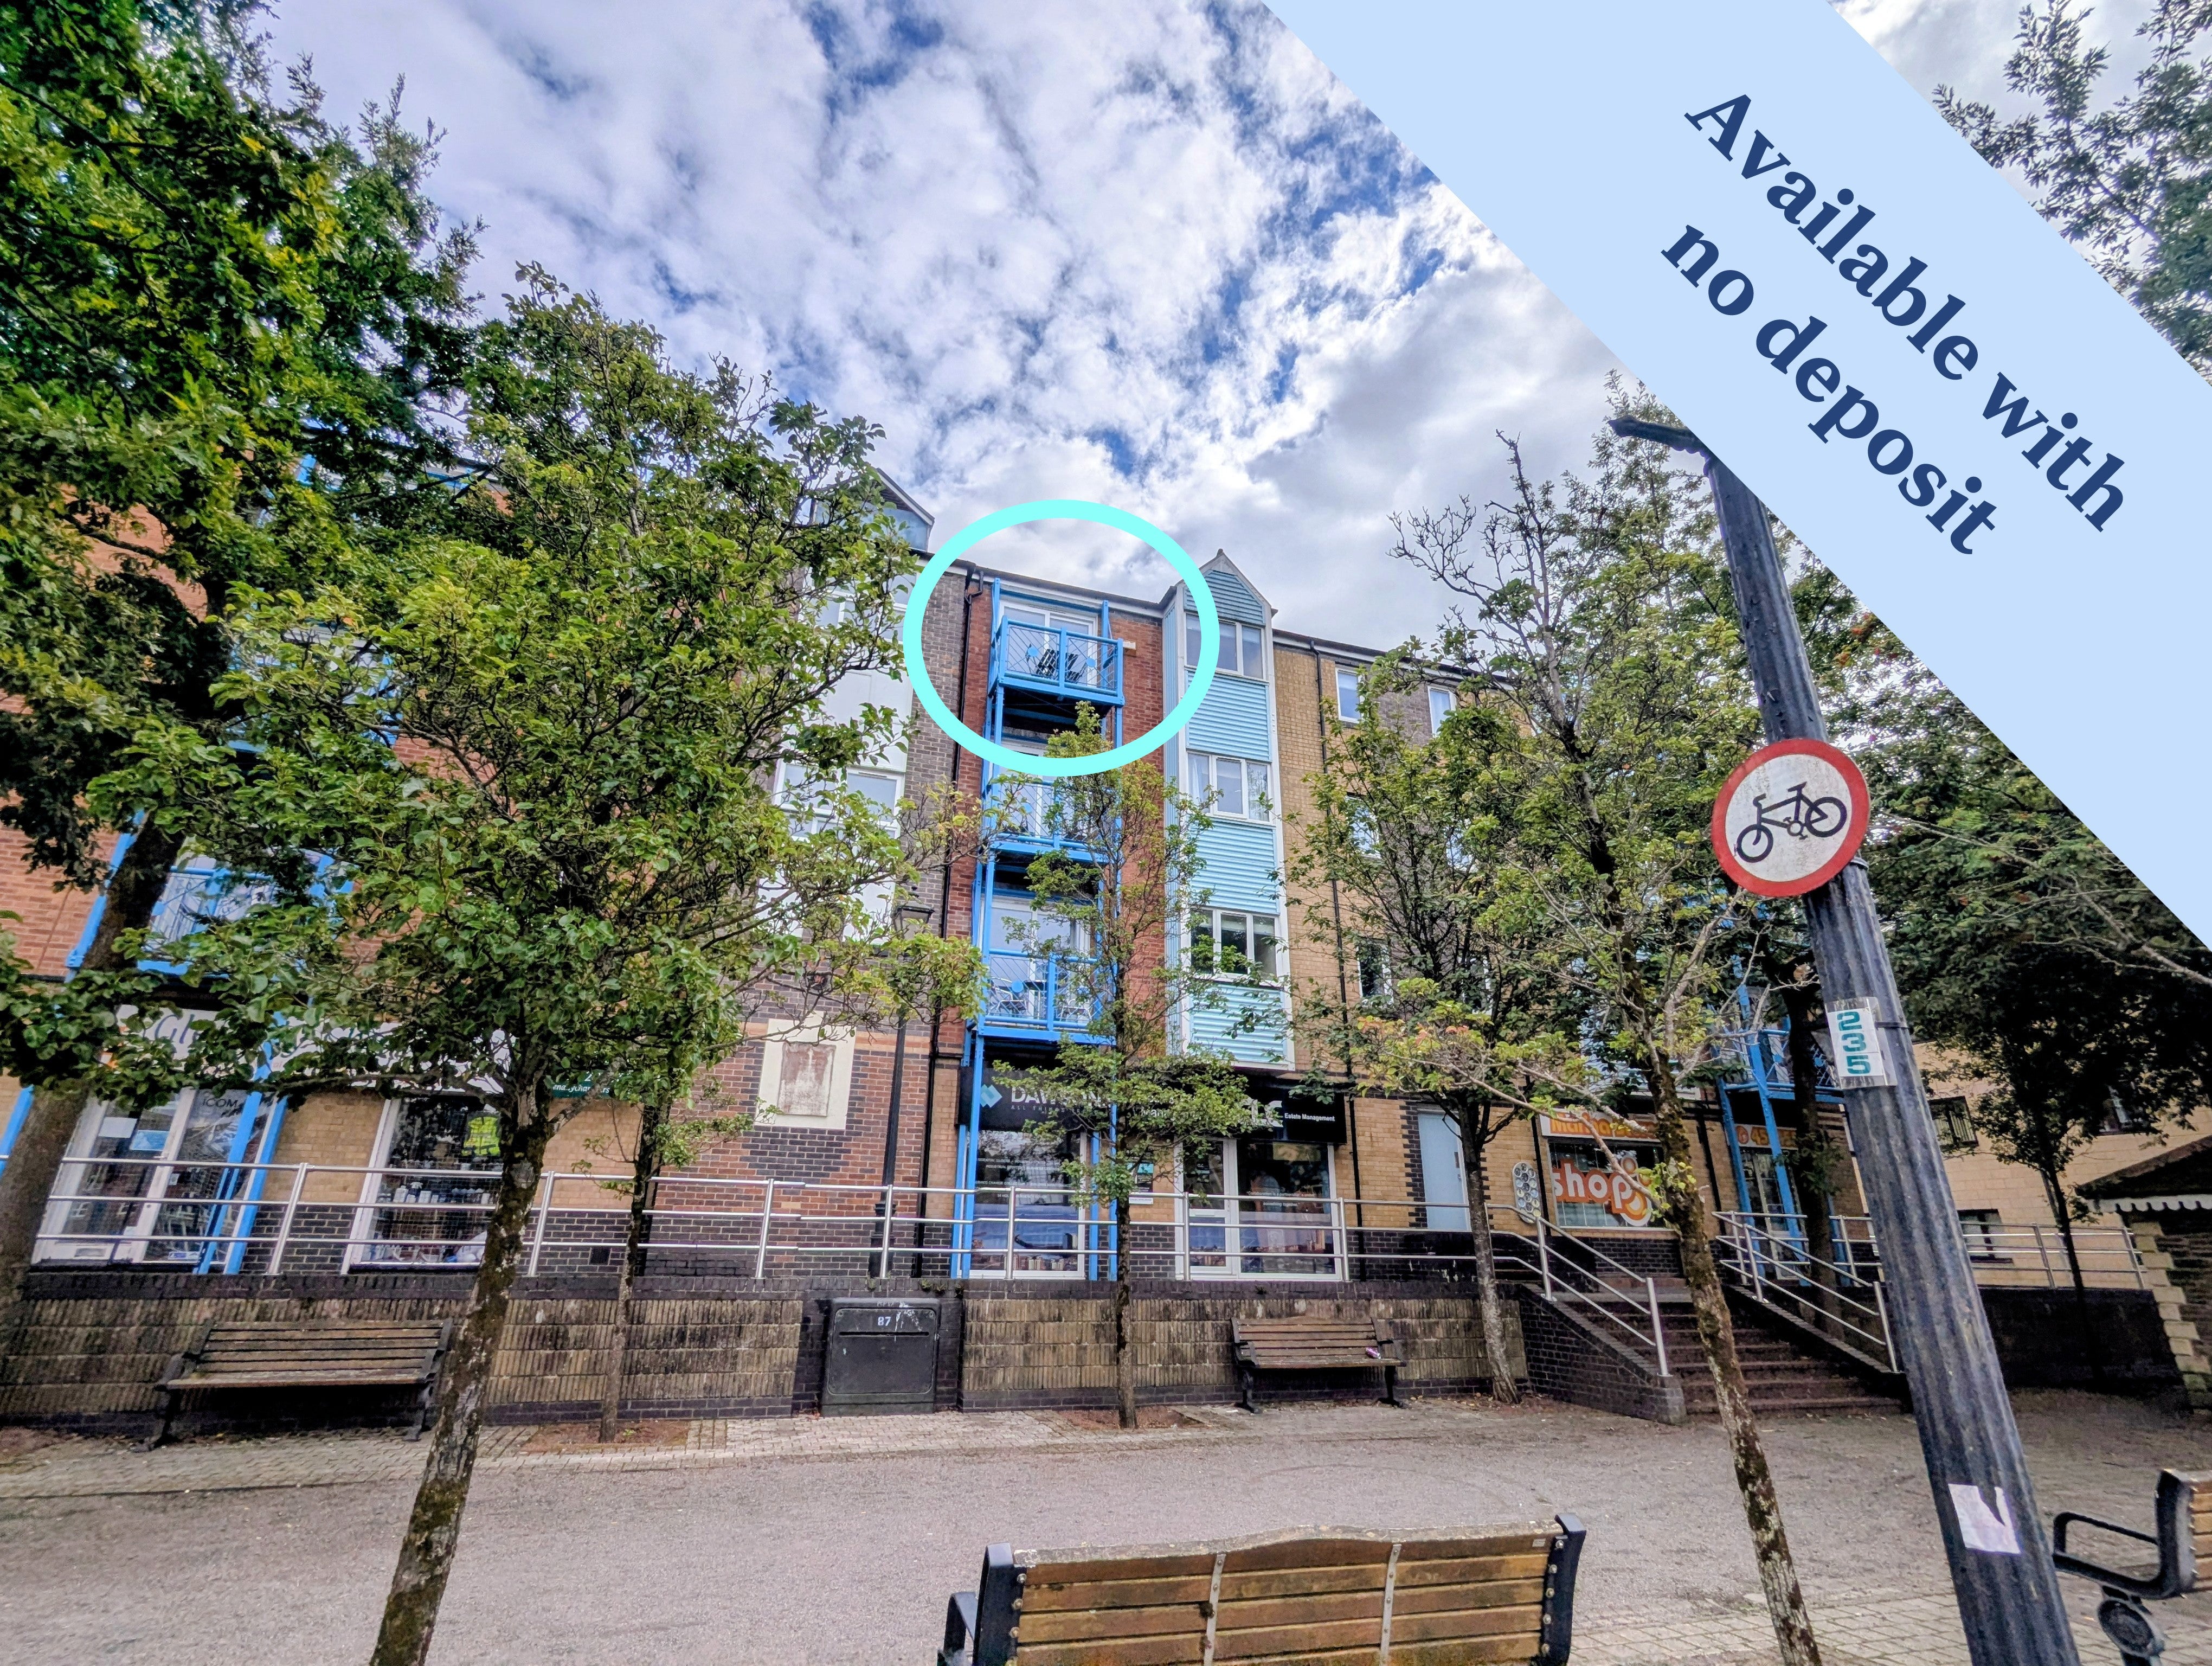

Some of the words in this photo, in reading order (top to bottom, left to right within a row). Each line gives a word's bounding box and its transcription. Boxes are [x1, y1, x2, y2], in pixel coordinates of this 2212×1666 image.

[1837, 1011, 1871, 1074] 235
[1302, 1113, 1335, 1122] Management
[878, 1316, 891, 1327] 87
